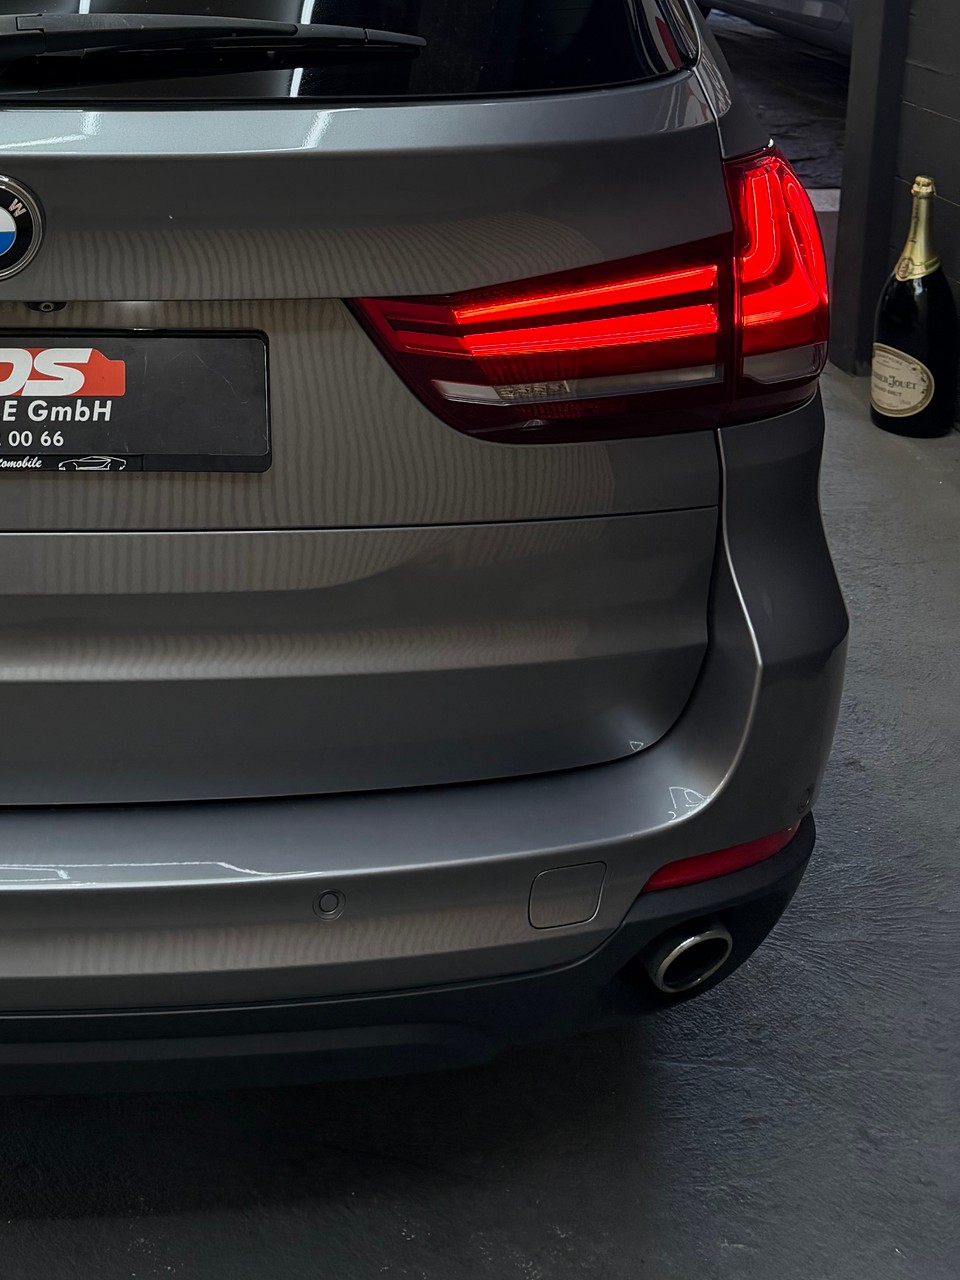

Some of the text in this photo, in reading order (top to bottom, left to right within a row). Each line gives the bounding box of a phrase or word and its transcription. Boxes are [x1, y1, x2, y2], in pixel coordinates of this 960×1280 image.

[28, 399, 112, 422] GmbH
[8, 431, 33, 447] 00
[40, 431, 64, 447] 66
